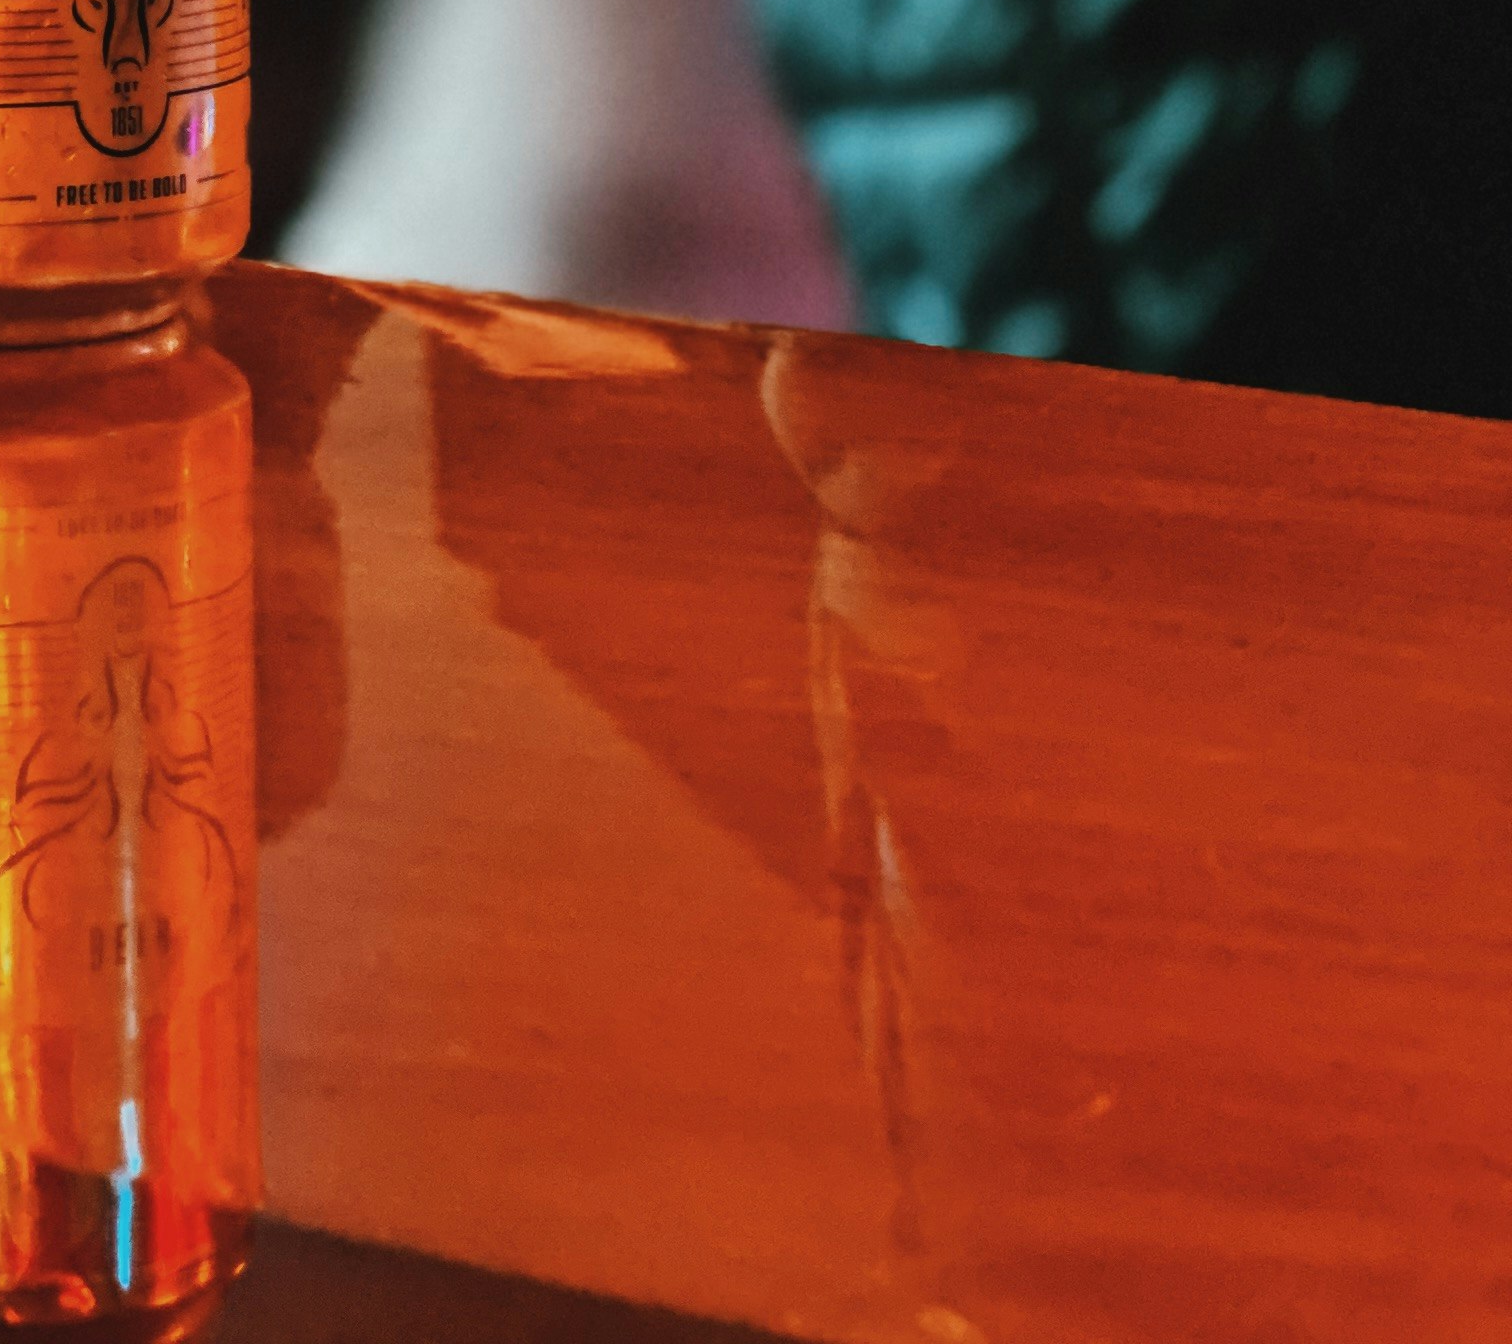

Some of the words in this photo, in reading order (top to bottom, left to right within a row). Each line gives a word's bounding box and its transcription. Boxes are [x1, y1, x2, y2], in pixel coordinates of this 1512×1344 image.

[111, 105, 143, 138] 1851
[56, 183, 98, 208] FREE
[103, 180, 122, 204] TO
[128, 178, 147, 202] BE
[152, 173, 187, 199] BOLD
